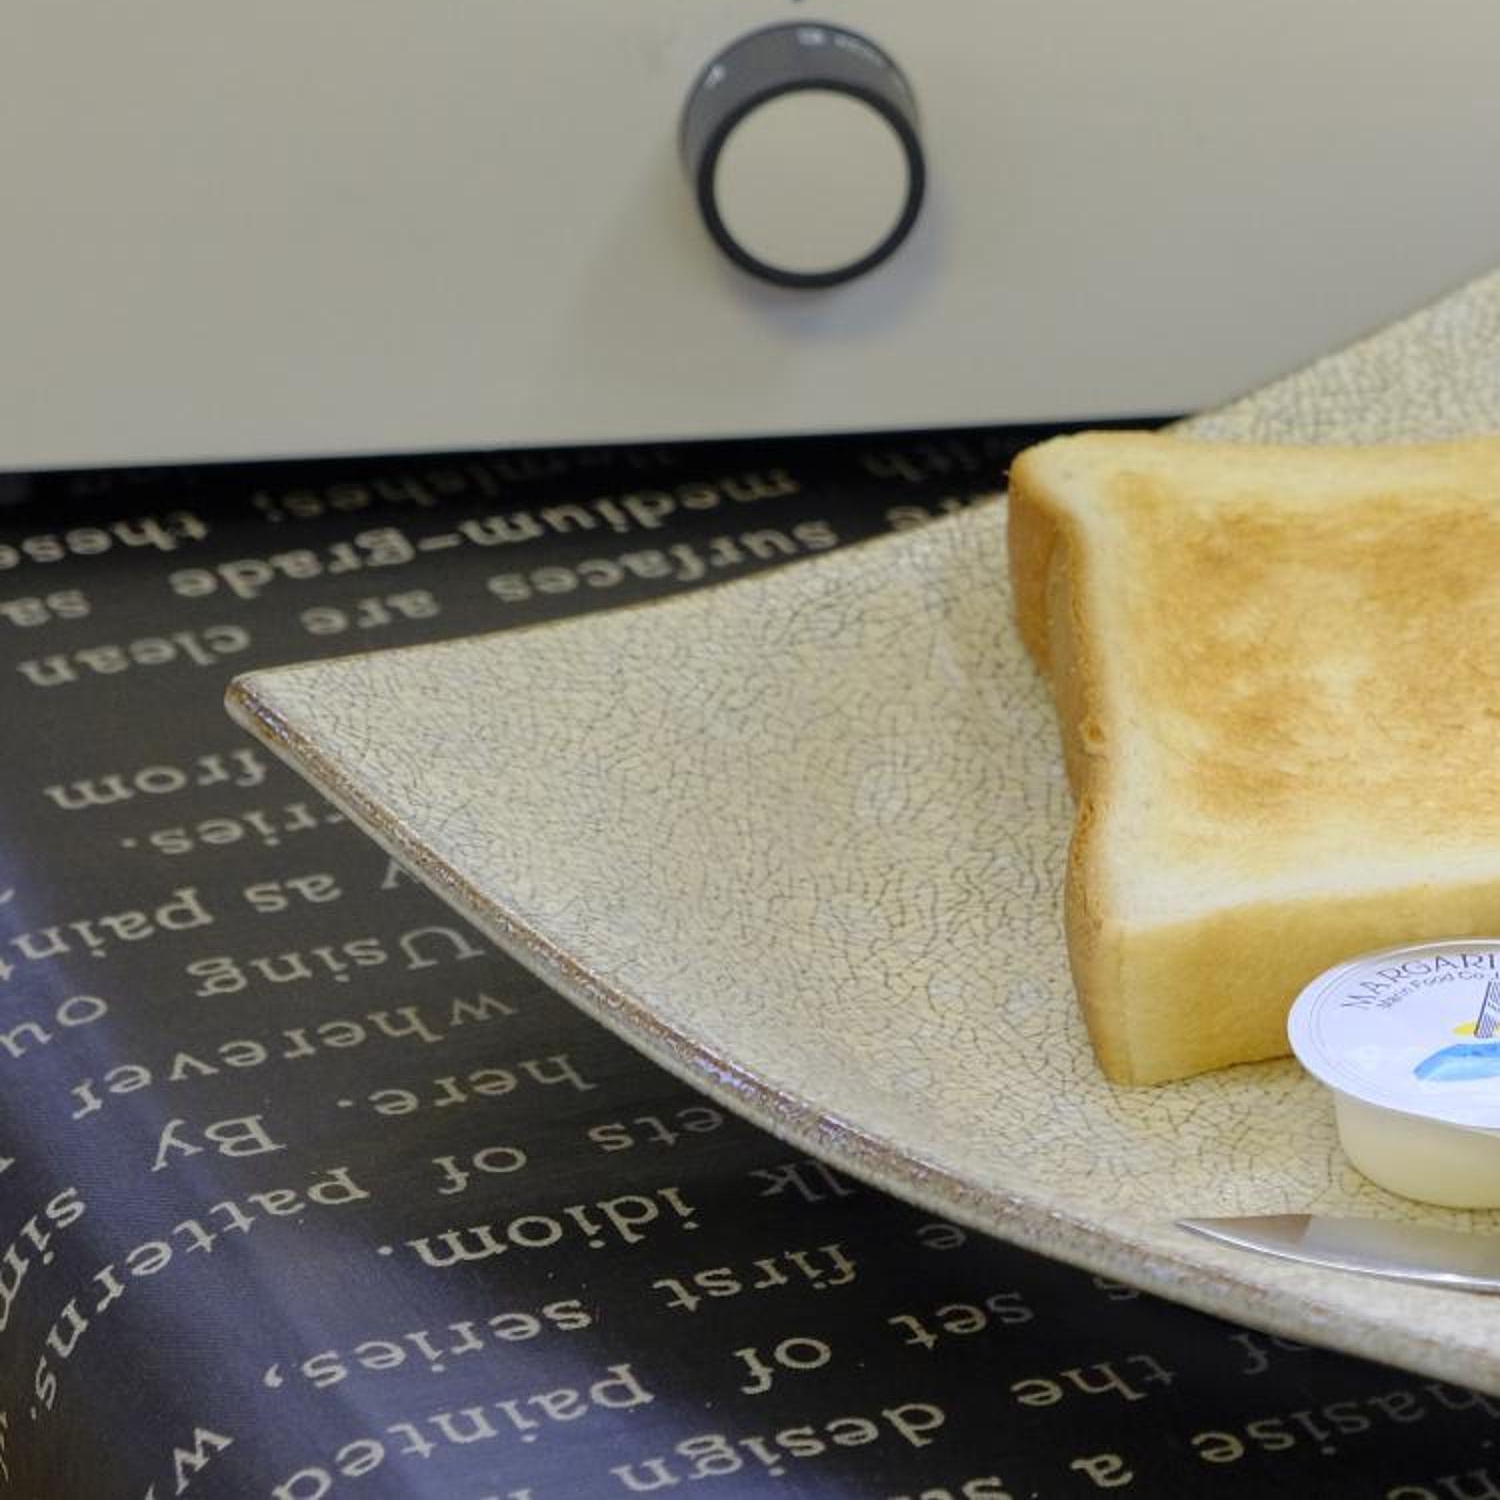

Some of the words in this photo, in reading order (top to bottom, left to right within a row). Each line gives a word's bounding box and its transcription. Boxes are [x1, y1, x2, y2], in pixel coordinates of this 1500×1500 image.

[168, 468, 800, 601] medium-grade
[485, 519, 839, 604] surfaces
[299, 589, 442, 637] are
[15, 624, 251, 689] clean
[42, 747, 268, 813] from
[243, 872, 343, 914] as
[185, 924, 485, 999] Using
[68, 992, 516, 1121] wherever
[336, 1054, 597, 1121] here.
[150, 1113, 287, 1173] By
[430, 1146, 528, 1195] of
[375, 1186, 697, 1271] idiom.
[652, 1243, 859, 1314] first
[262, 1299, 593, 1394] series,
[887, 1290, 1036, 1352] set
[732, 1337, 833, 1396] of
[1008, 1352, 1176, 1409] the
[607, 1402, 947, 1497] design
[1070, 1453, 1134, 1488] a
